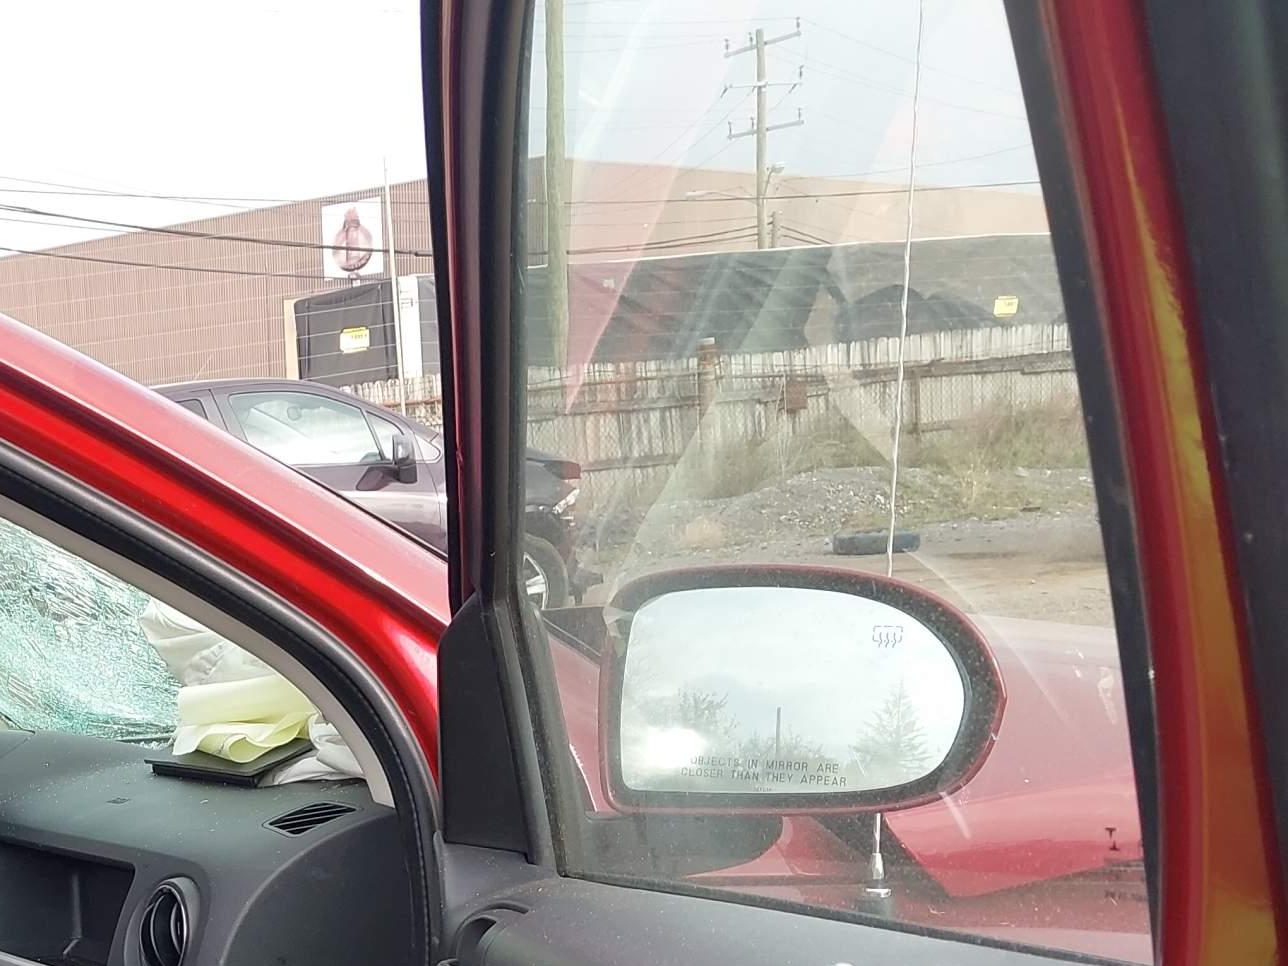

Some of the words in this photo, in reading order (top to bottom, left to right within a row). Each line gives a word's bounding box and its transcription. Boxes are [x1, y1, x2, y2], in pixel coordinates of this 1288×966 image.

[691, 756, 739, 767] OBJECTS
[747, 759, 759, 769] IN
[765, 760, 809, 772] MIRROR
[816, 763, 840, 774] ARE
[681, 767, 723, 778] CLOSER
[730, 770, 759, 781] THAN
[765, 772, 794, 783] THEY
[799, 774, 847, 787] APPEAR
